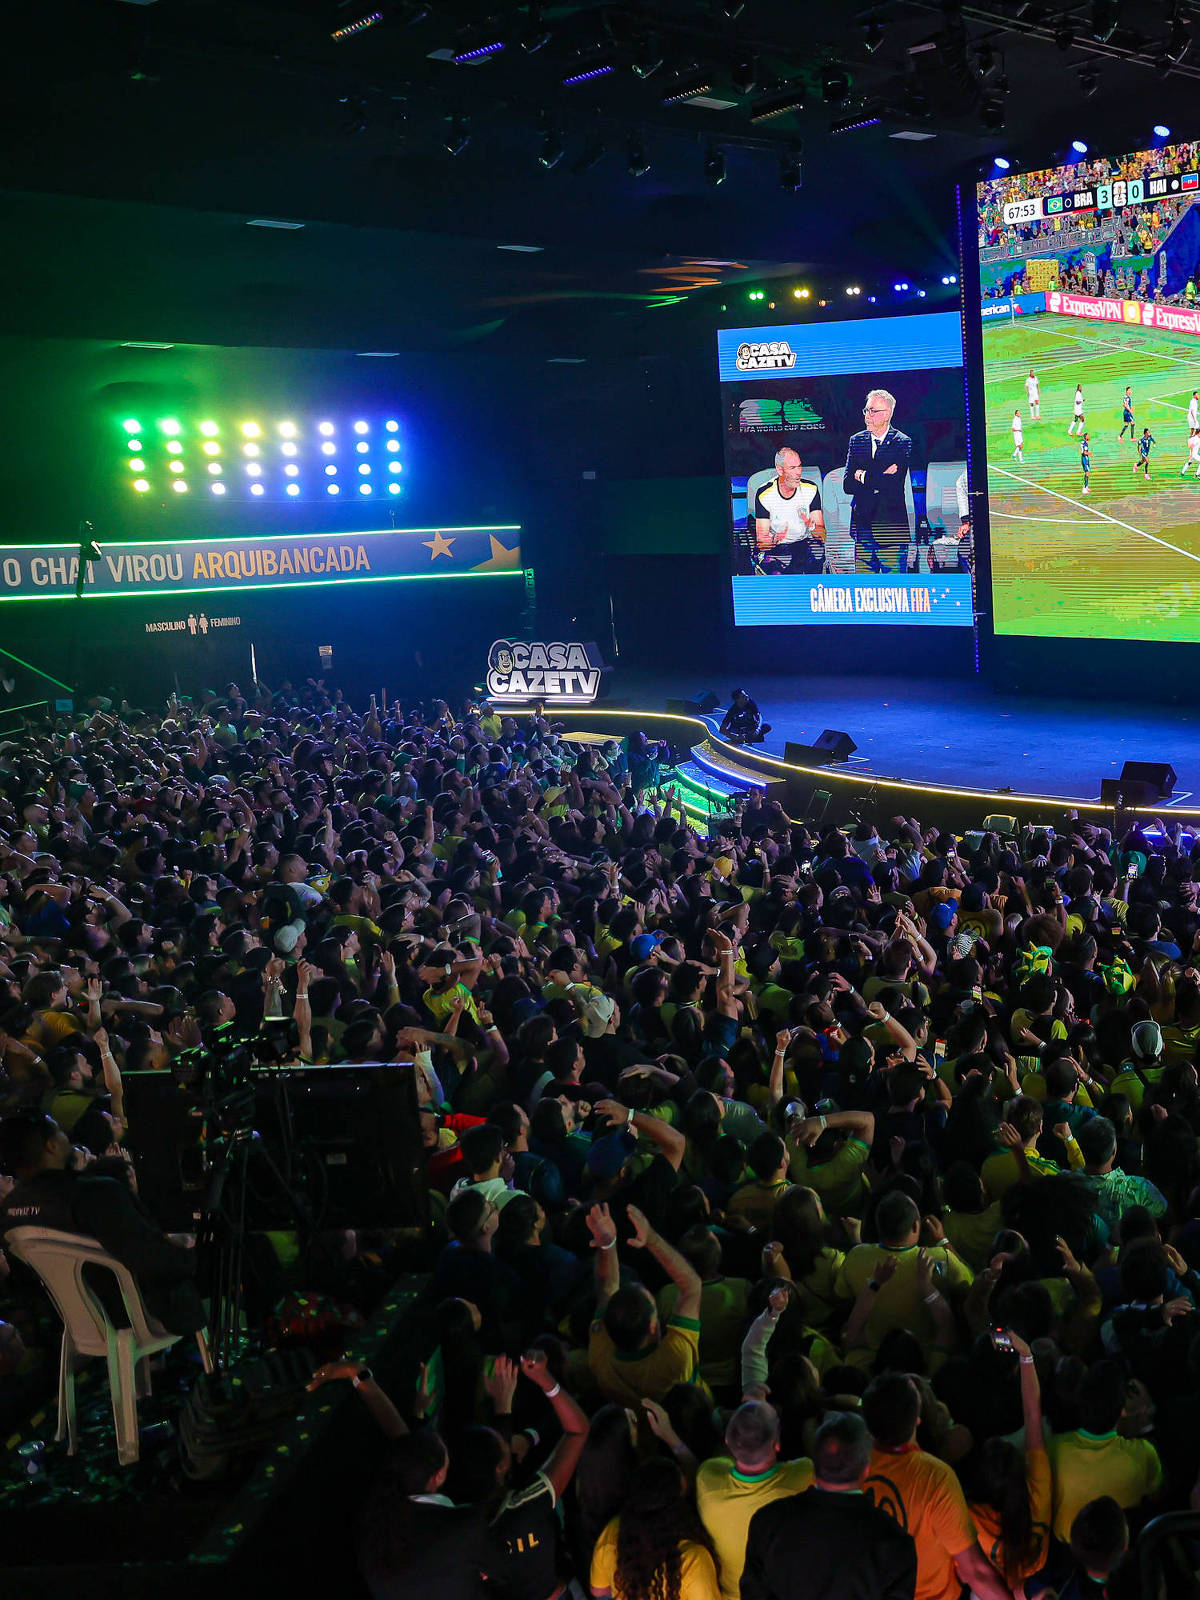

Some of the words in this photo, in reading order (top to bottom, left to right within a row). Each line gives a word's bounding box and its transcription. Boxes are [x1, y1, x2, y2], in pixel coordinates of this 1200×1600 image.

[1132, 184, 1139, 199] 0
[1150, 178, 1167, 195] HAI
[1074, 191, 1093, 208] BRA
[1101, 190, 1108, 204] 3
[1008, 204, 1036, 220] 67:53
[1063, 296, 1121, 320] ExpressVPN
[750, 343, 790, 357] CASA
[737, 354, 795, 369] CAZETV
[3, 558, 22, 587] O
[106, 553, 184, 583] VIROU
[192, 545, 371, 580] ARQUIBANCADA
[810, 583, 853, 612] CÂMERA
[854, 587, 910, 612] EXCLUSIVA
[910, 587, 931, 612] FIFA
[145, 621, 186, 632] MASCULINO
[512, 645, 588, 670] CASA
[489, 670, 597, 694] CAZETV
